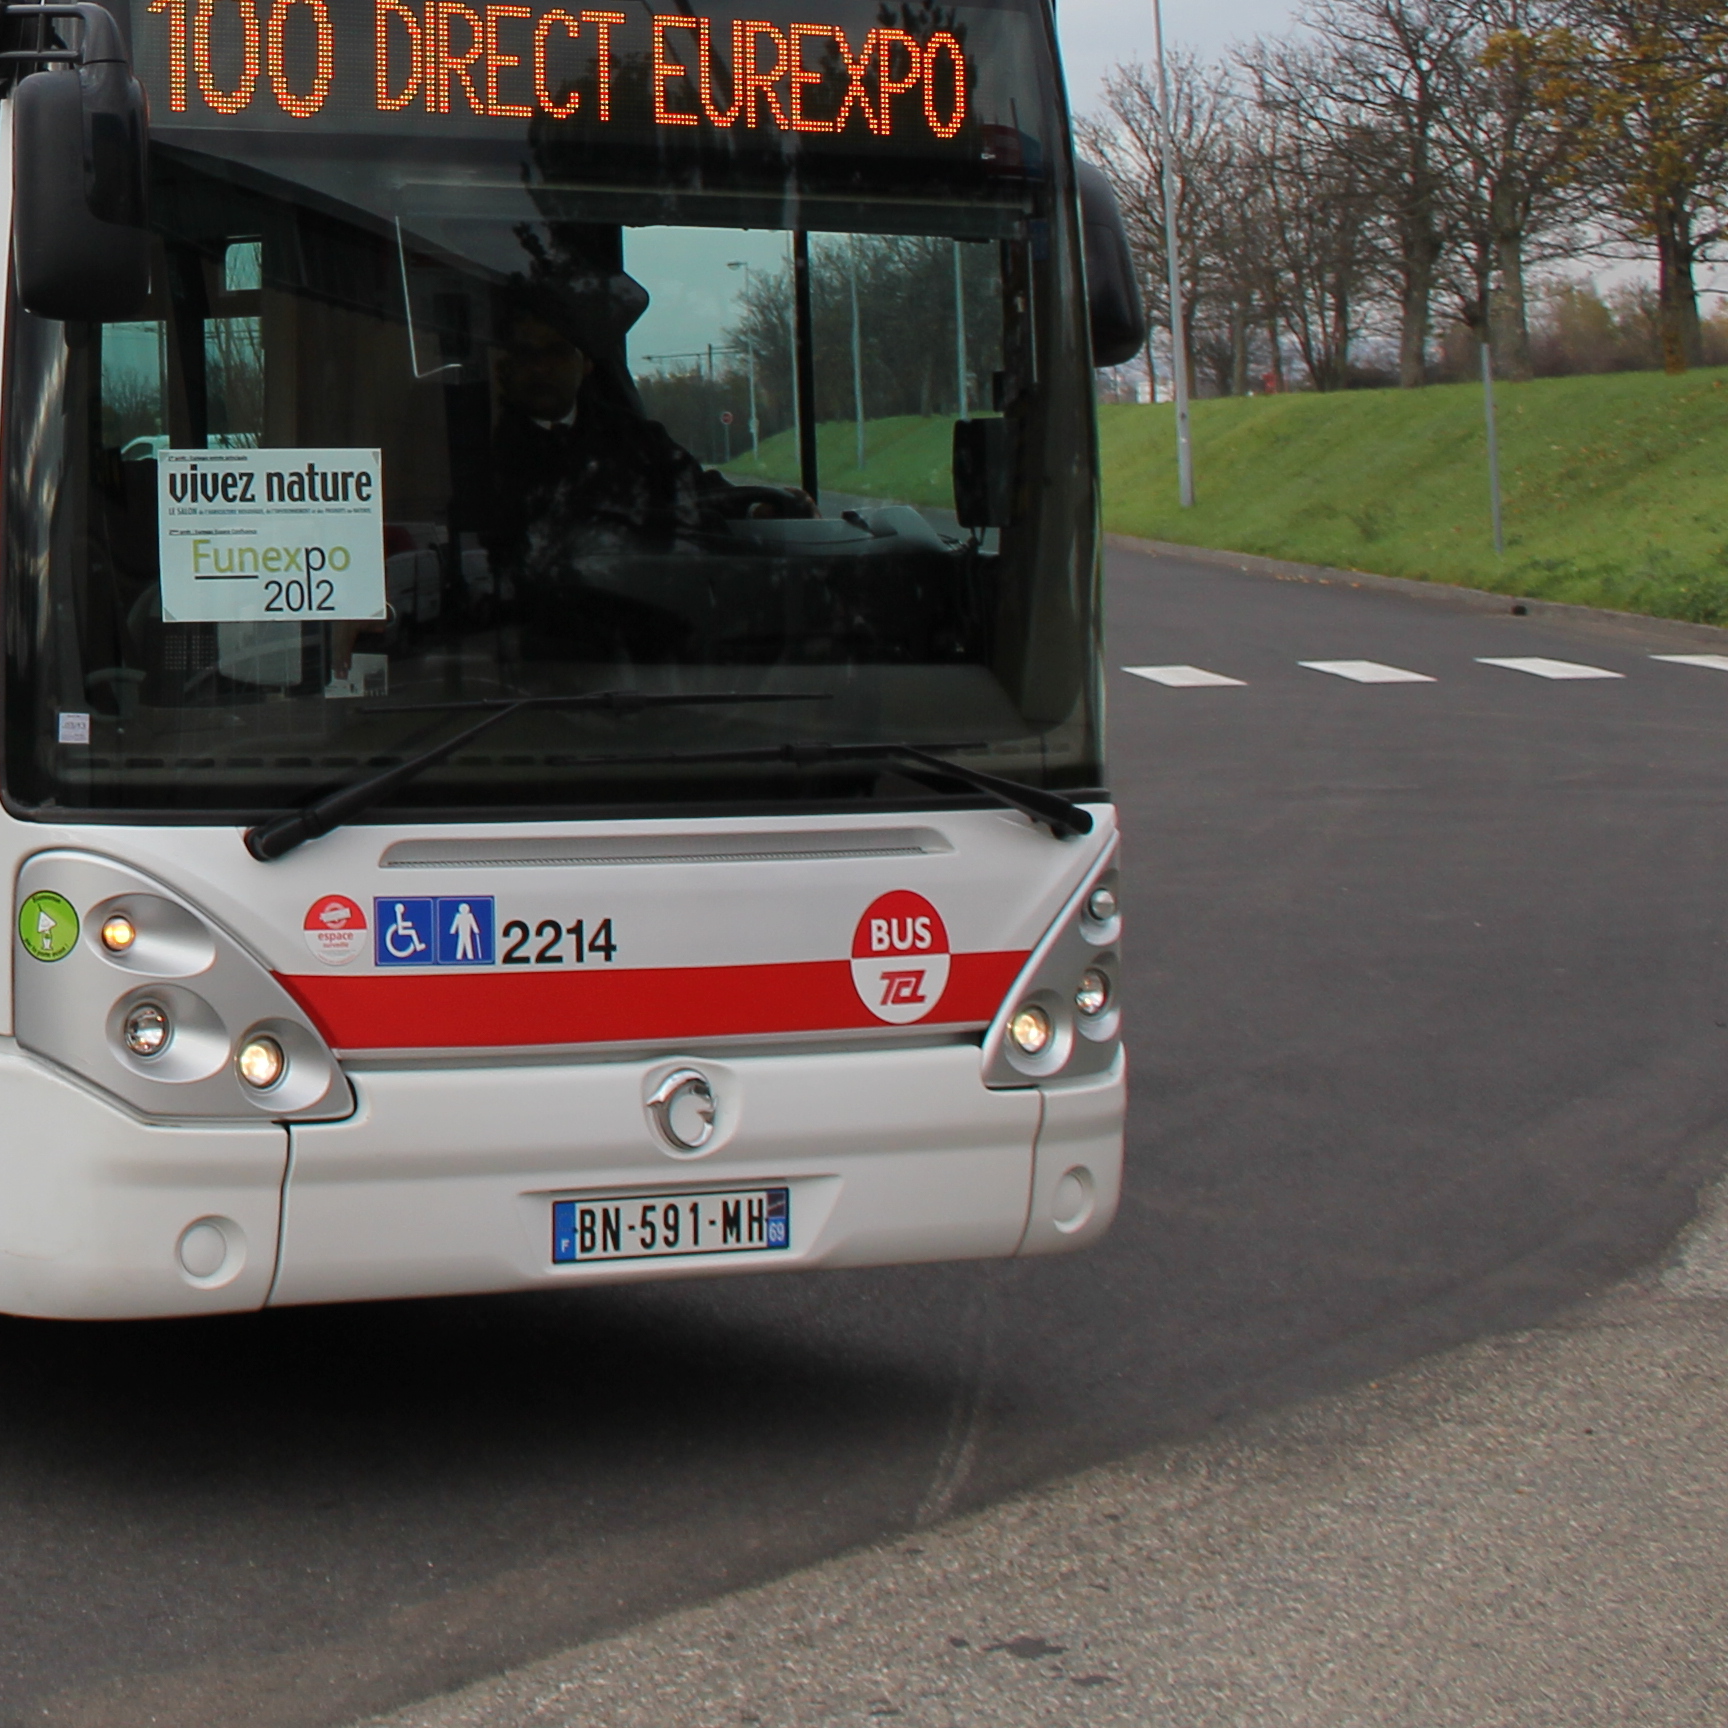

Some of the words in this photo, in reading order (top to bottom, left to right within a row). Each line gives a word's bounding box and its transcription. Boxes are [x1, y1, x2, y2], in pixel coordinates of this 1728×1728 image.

[652, 14, 967, 139] EUREXPO
[167, 463, 256, 504] vivez
[265, 462, 372, 503] nature
[192, 538, 352, 576] Funexpo
[263, 579, 336, 613] 2012
[501, 918, 618, 966] 2214
[870, 915, 932, 952] BUS
[879, 969, 928, 1006] TCL
[561, 1238, 570, 1253] F
[579, 1198, 764, 1253] BN-591-MH
[769, 1221, 785, 1243] 69
